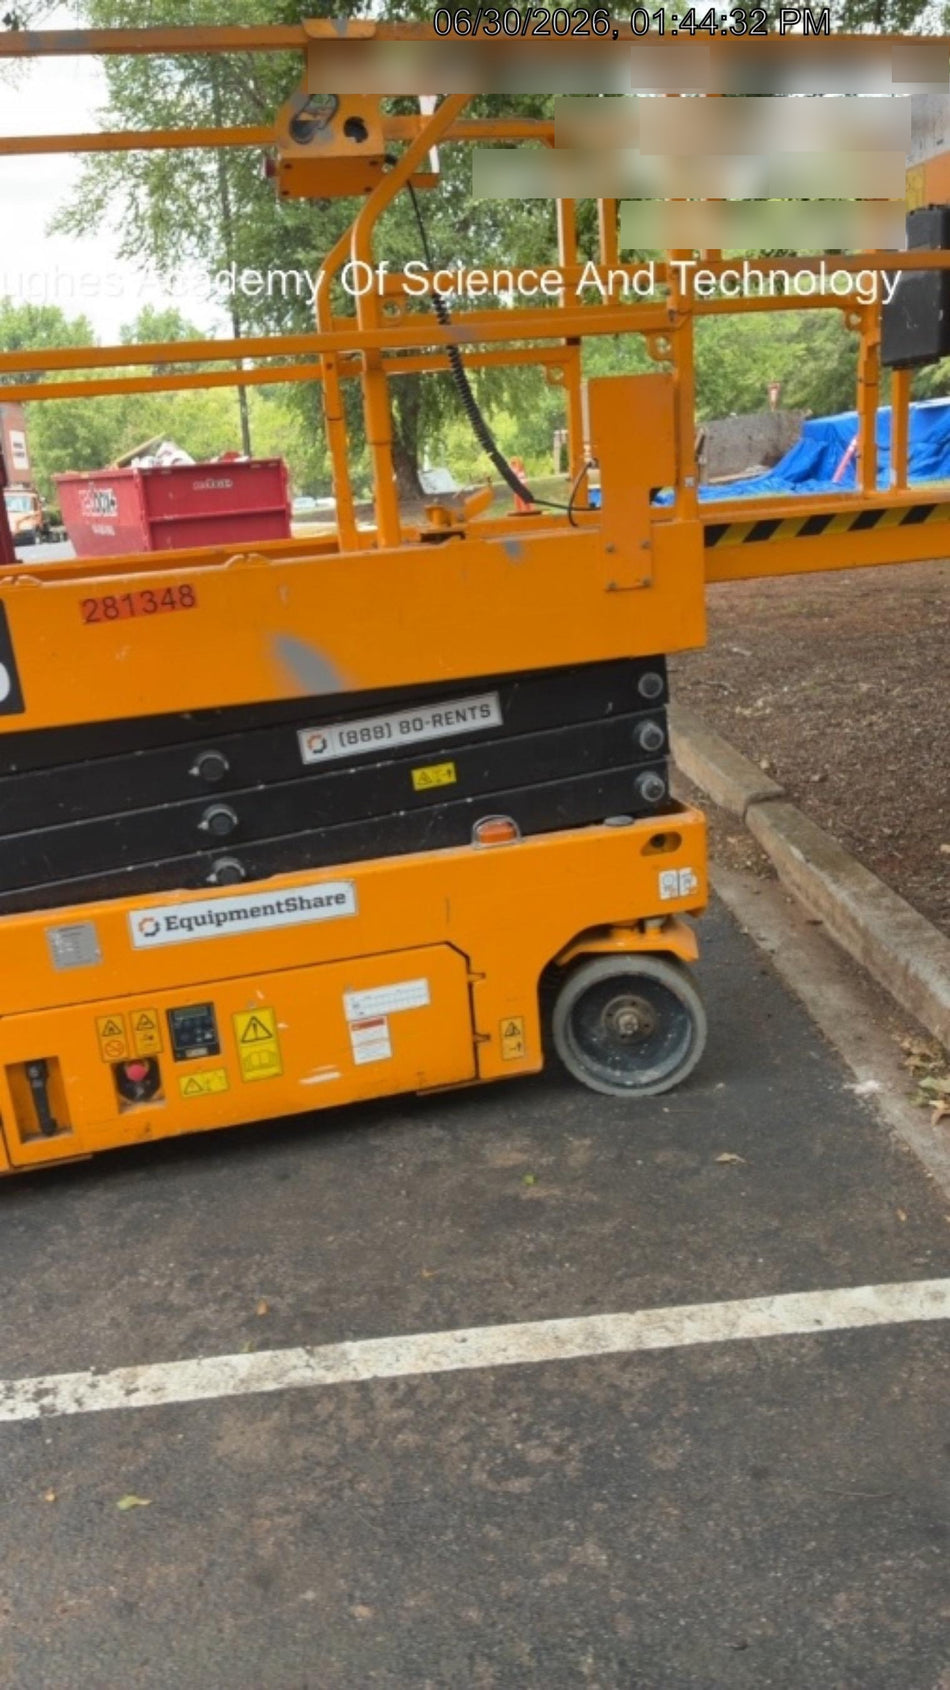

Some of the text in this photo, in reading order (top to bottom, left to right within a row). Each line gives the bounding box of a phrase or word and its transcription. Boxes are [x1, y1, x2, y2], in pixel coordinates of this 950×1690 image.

[82, 584, 195, 623] 281348
[339, 704, 492, 747] (888) 80-RENTS
[164, 892, 346, 932] EquipmentShare
